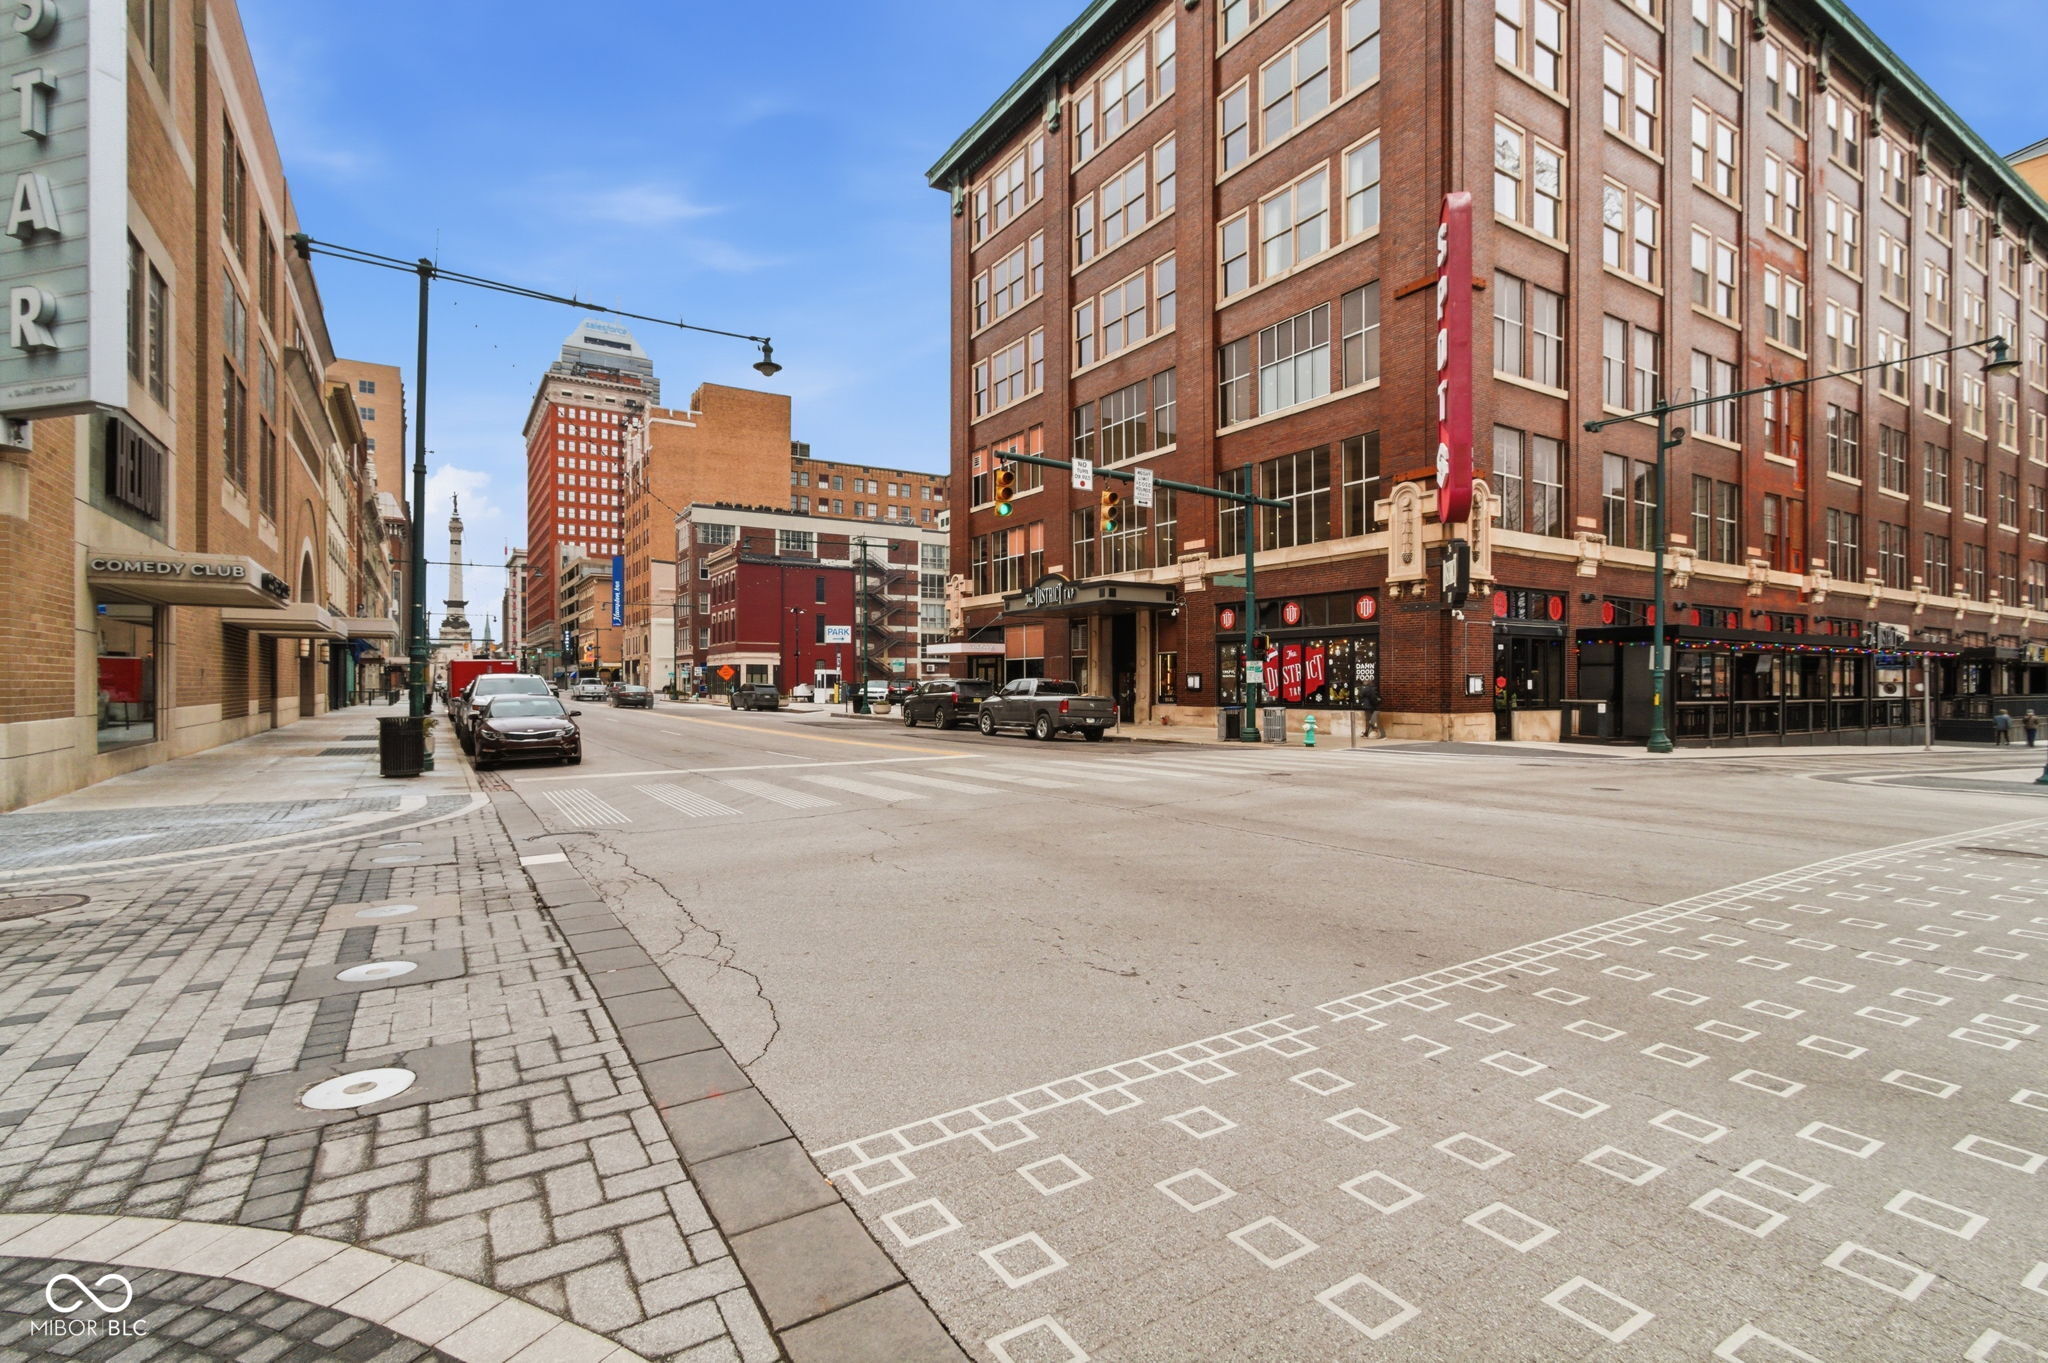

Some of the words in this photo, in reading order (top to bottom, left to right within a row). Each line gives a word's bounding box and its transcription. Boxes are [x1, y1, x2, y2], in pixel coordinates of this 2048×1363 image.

[91, 559, 185, 574] COMEDY
[191, 563, 246, 577] CLUB
[1035, 582, 1063, 608] DISTRICT
[827, 628, 850, 636] PARK
